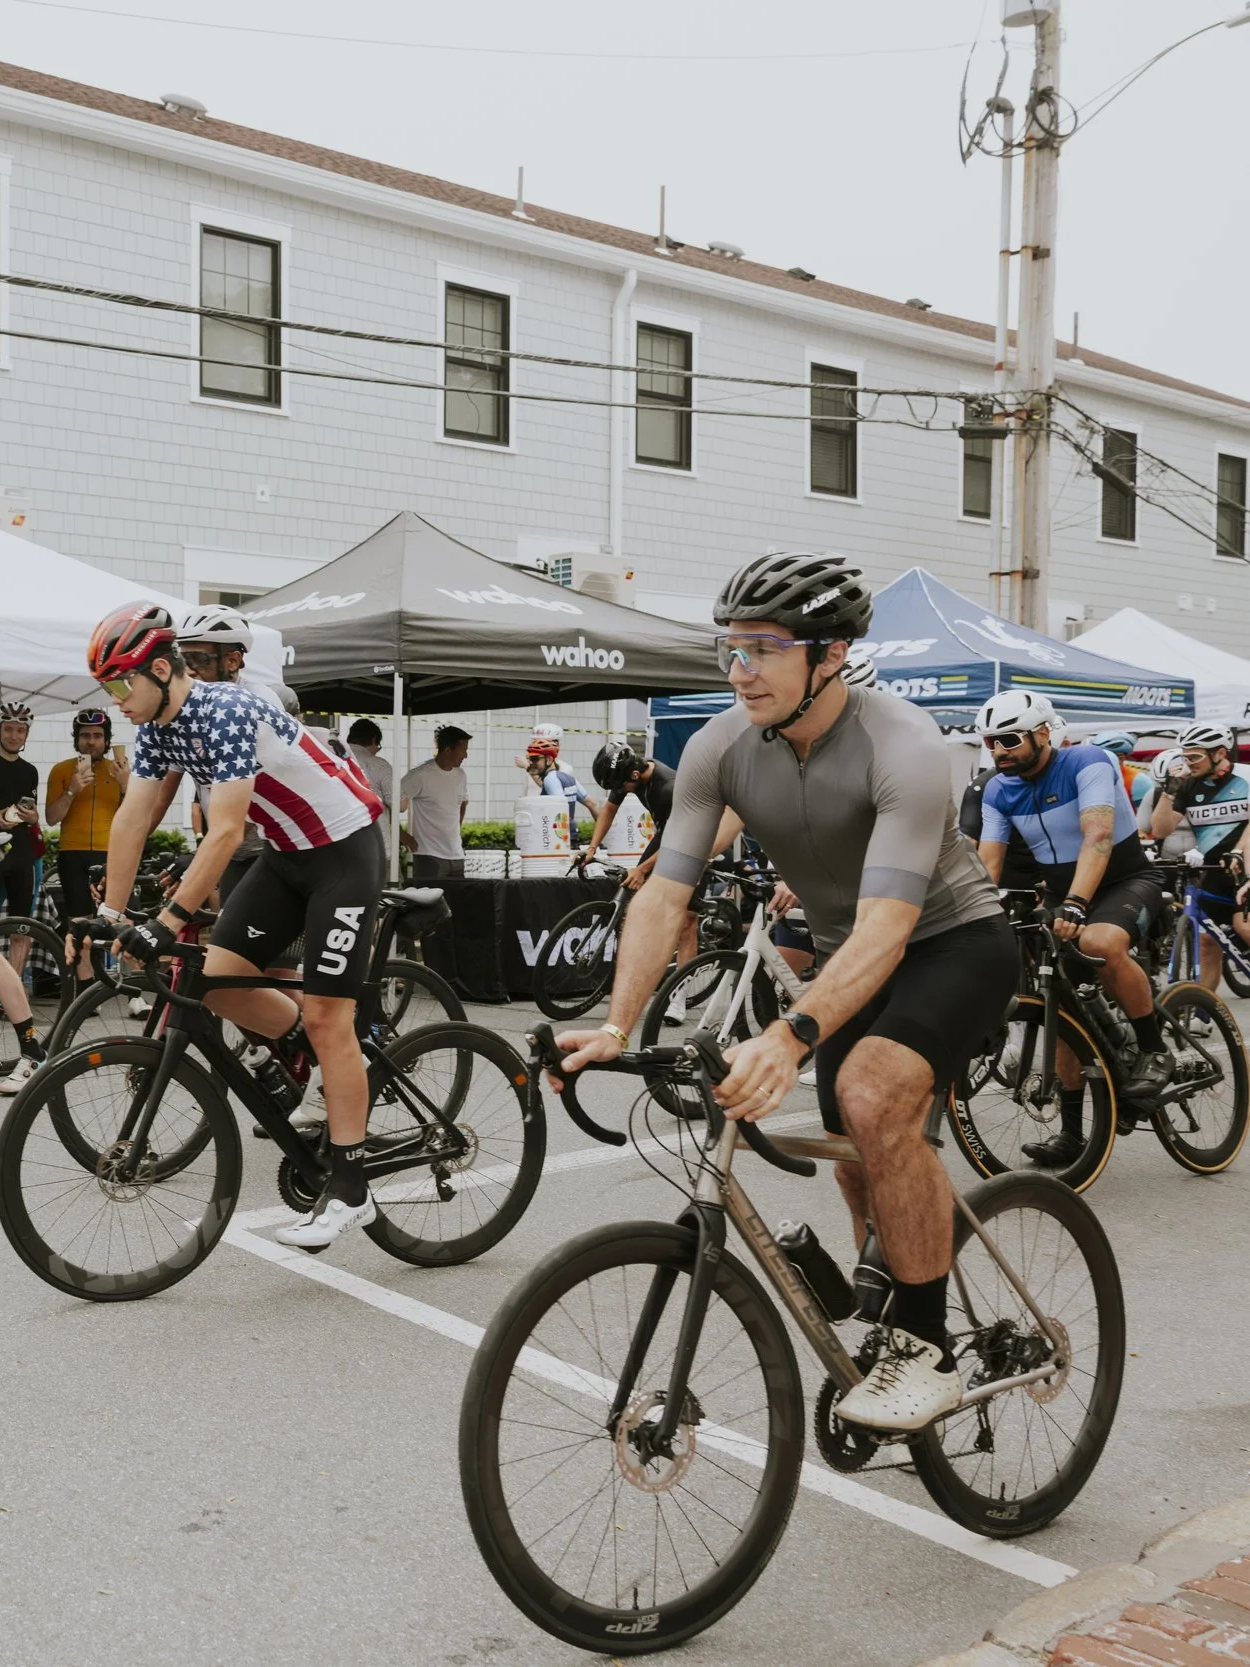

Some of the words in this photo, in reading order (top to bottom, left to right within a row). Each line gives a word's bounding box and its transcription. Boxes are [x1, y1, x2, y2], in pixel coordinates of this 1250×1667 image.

[436, 584, 584, 615] wahoo
[802, 588, 841, 615] LAZER
[541, 636, 625, 670] wahoo
[847, 638, 939, 664] OTS
[874, 677, 939, 698] OOTS
[1122, 686, 1172, 707] MOOTS
[1188, 802, 1249, 819] VICTORY
[134, 924, 159, 948] USA
[316, 906, 366, 976] USA
[955, 1099, 969, 1121] DT
[961, 1123, 987, 1160] SWISS
[345, 1148, 364, 1161] US
